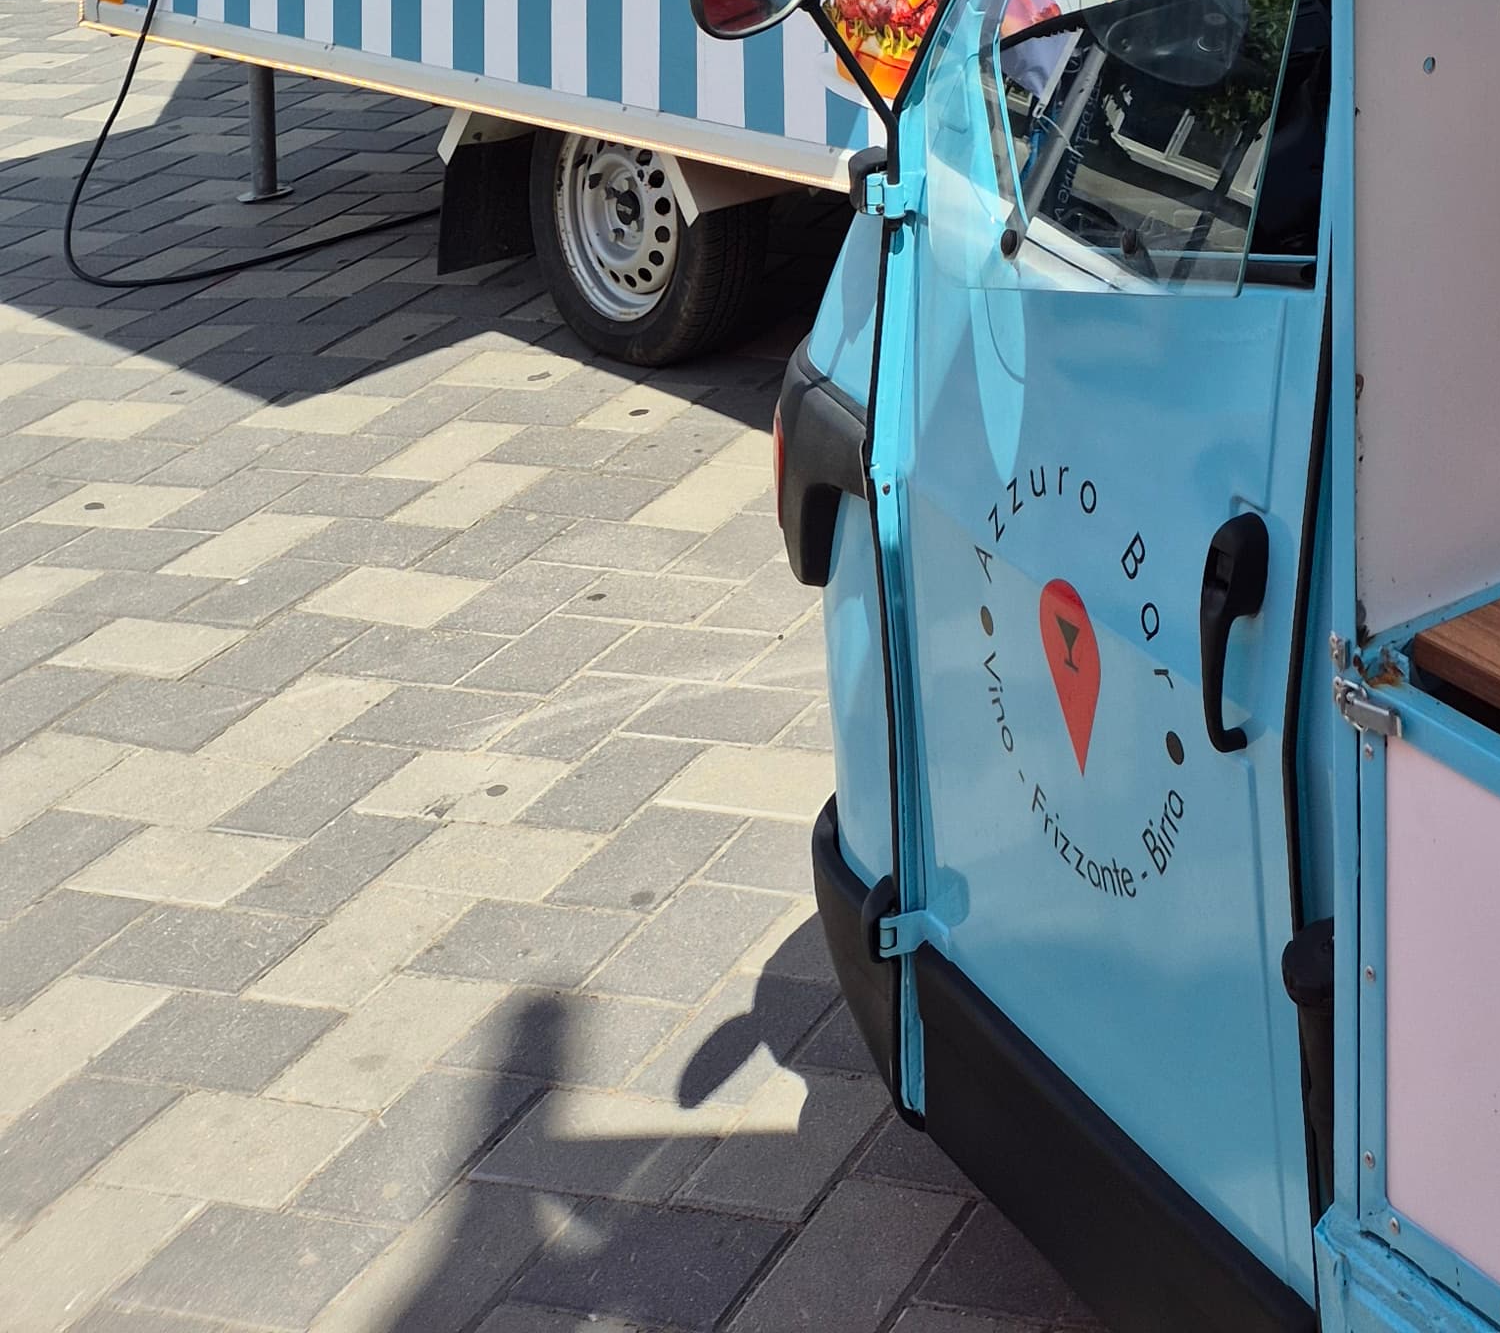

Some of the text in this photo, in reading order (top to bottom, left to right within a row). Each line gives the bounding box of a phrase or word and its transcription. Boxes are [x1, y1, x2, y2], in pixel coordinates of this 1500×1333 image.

[974, 464, 1176, 691] Azzuro Bar
[981, 651, 1186, 900] Vino Frizzante Birra
